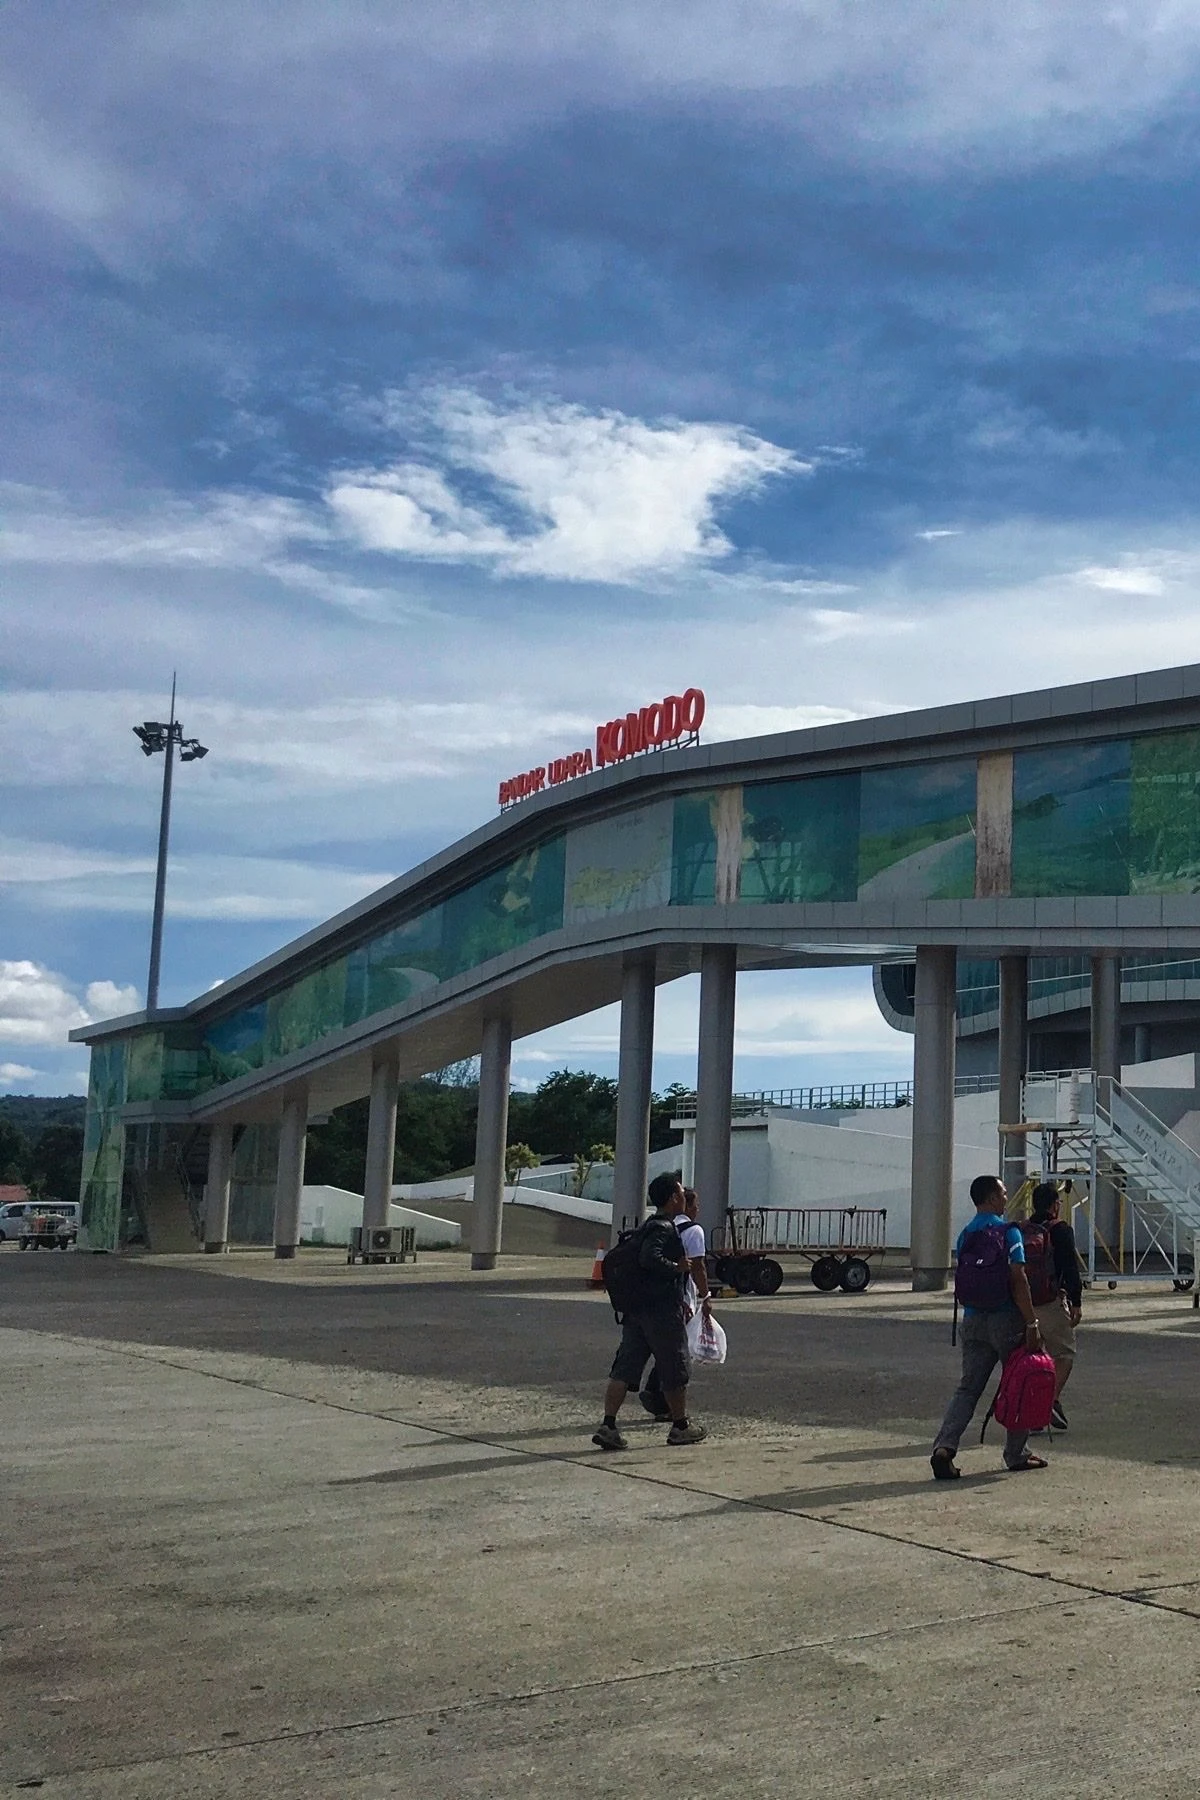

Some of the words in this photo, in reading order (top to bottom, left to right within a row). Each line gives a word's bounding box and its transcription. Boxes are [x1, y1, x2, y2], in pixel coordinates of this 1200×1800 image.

[498, 766, 546, 804] BANDAR
[548, 748, 593, 785] UDARA
[595, 687, 705, 767] KOMODO
[1133, 1124, 1183, 1176] MENARA
